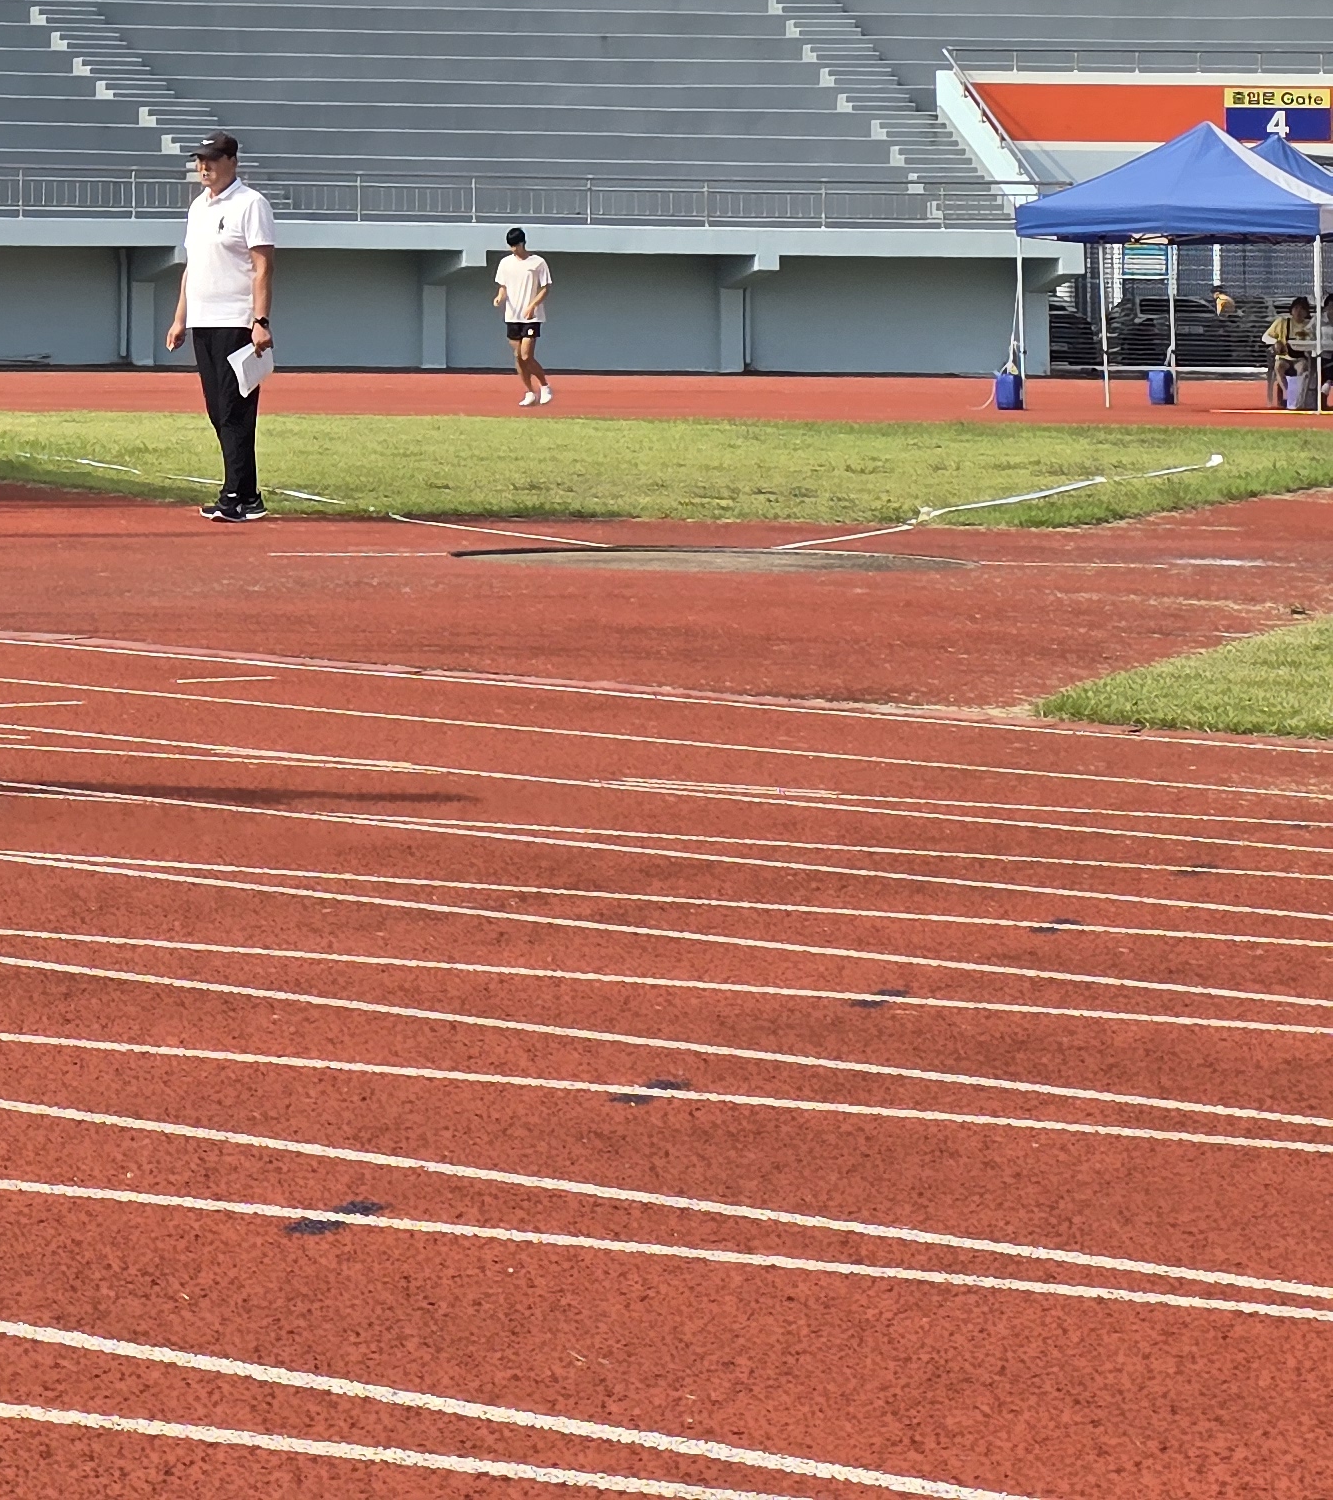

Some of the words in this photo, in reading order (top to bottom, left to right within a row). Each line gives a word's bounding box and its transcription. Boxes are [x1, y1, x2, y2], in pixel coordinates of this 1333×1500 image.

[1232, 91, 1275, 105] 출입문
[1280, 91, 1324, 106] Gate
[1266, 110, 1290, 138] 4
